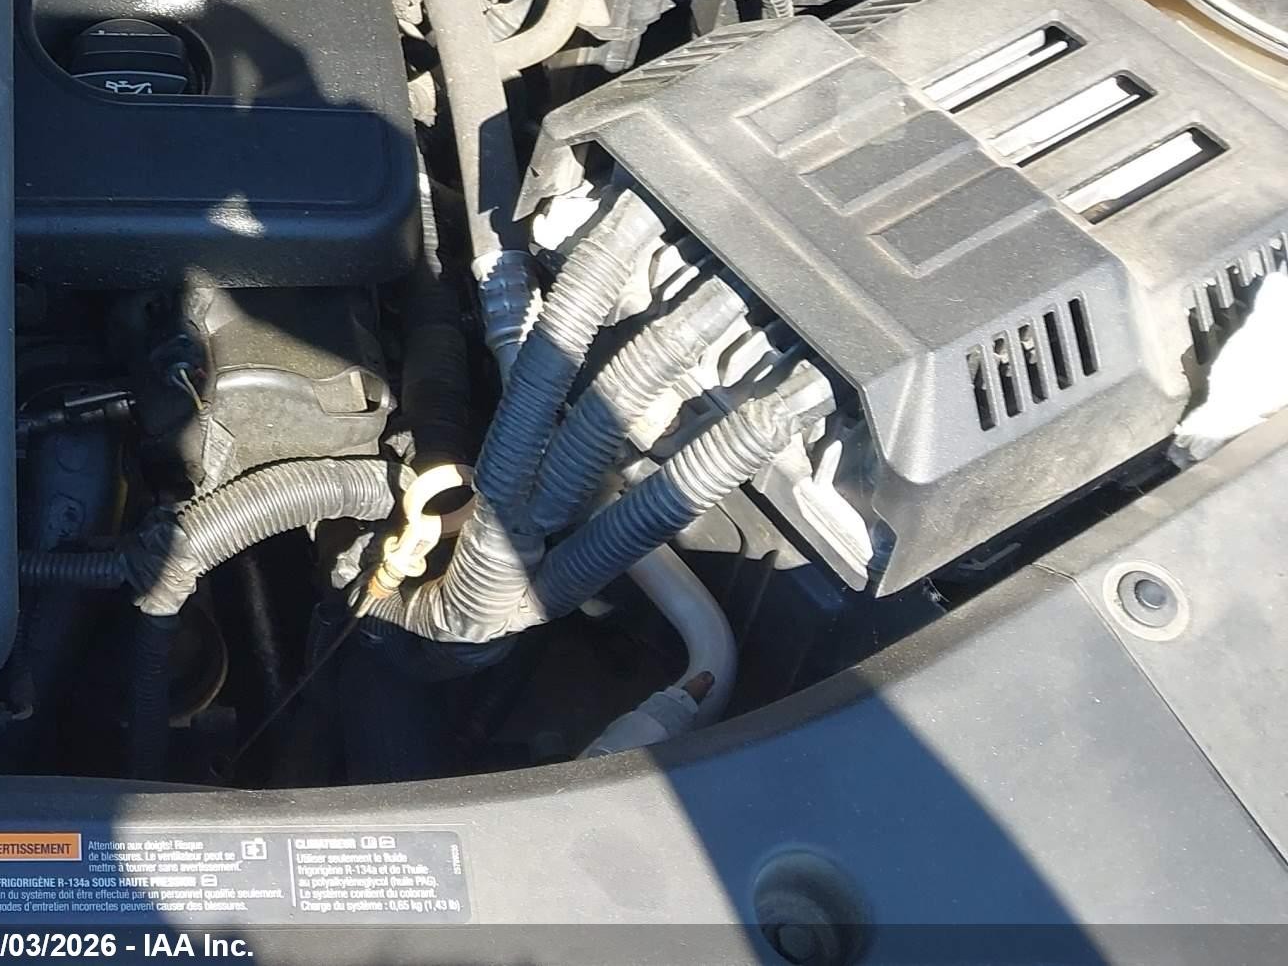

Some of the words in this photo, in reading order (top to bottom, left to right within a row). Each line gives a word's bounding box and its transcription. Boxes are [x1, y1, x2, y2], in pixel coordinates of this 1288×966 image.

[88, 840, 125, 851] Attention
[127, 842, 142, 851] aux
[88, 852, 98, 862] de
[89, 863, 116, 872] mettre
[118, 862, 125, 872] à
[58, 877, 90, 887] R-134a
[92, 877, 117, 888] SOUS
[119, 876, 149, 887] HAUTE
[8, 889, 19, 899] du
[21, 889, 56, 901] système
[58, 889, 74, 899] doit
[76, 889, 93, 899] être
[95, 889, 130, 899] effectué
[132, 891, 146, 901] par
[148, 890, 159, 899] un
[24, 902, 70, 912] d'entretien
[71, 902, 119, 912] incorrectes
[120, 902, 154, 913] peuvent
